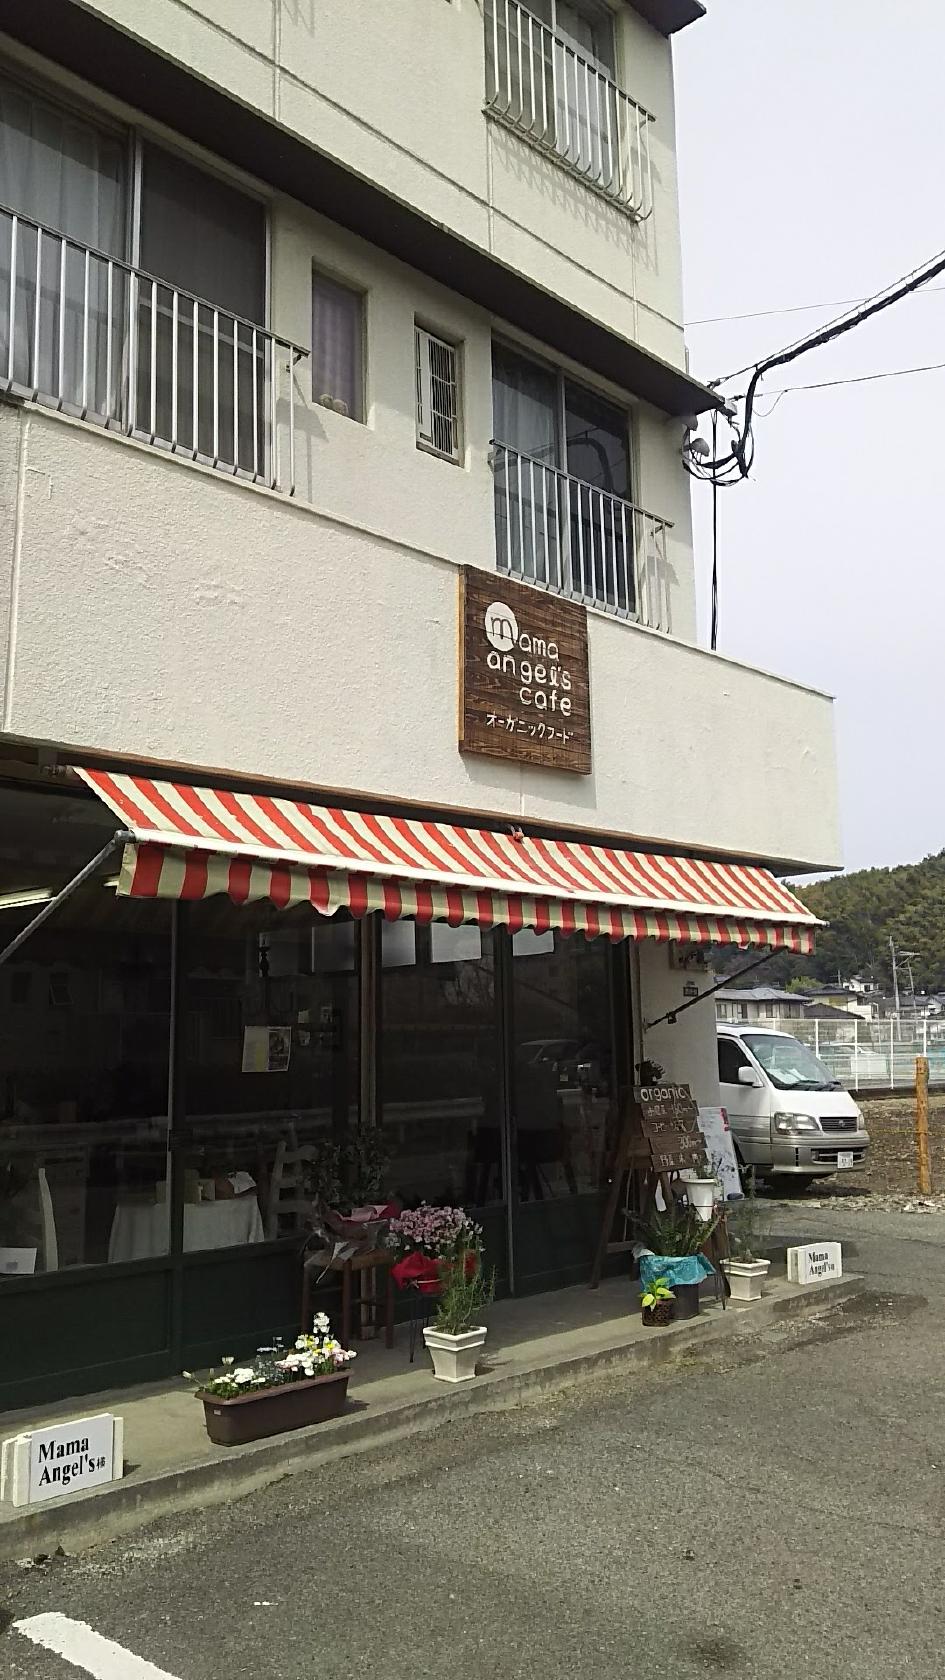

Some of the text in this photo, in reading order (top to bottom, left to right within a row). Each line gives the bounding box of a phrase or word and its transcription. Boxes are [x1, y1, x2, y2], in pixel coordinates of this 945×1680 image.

[487, 651, 572, 690] angel's
[519, 686, 572, 717] cafe
[486, 710, 574, 744] オーガニックフード
[640, 1087, 686, 1101] organic
[808, 1252, 828, 1263] Mama
[38, 1437, 89, 1463] Mama
[38, 1453, 95, 1486] Angel's
